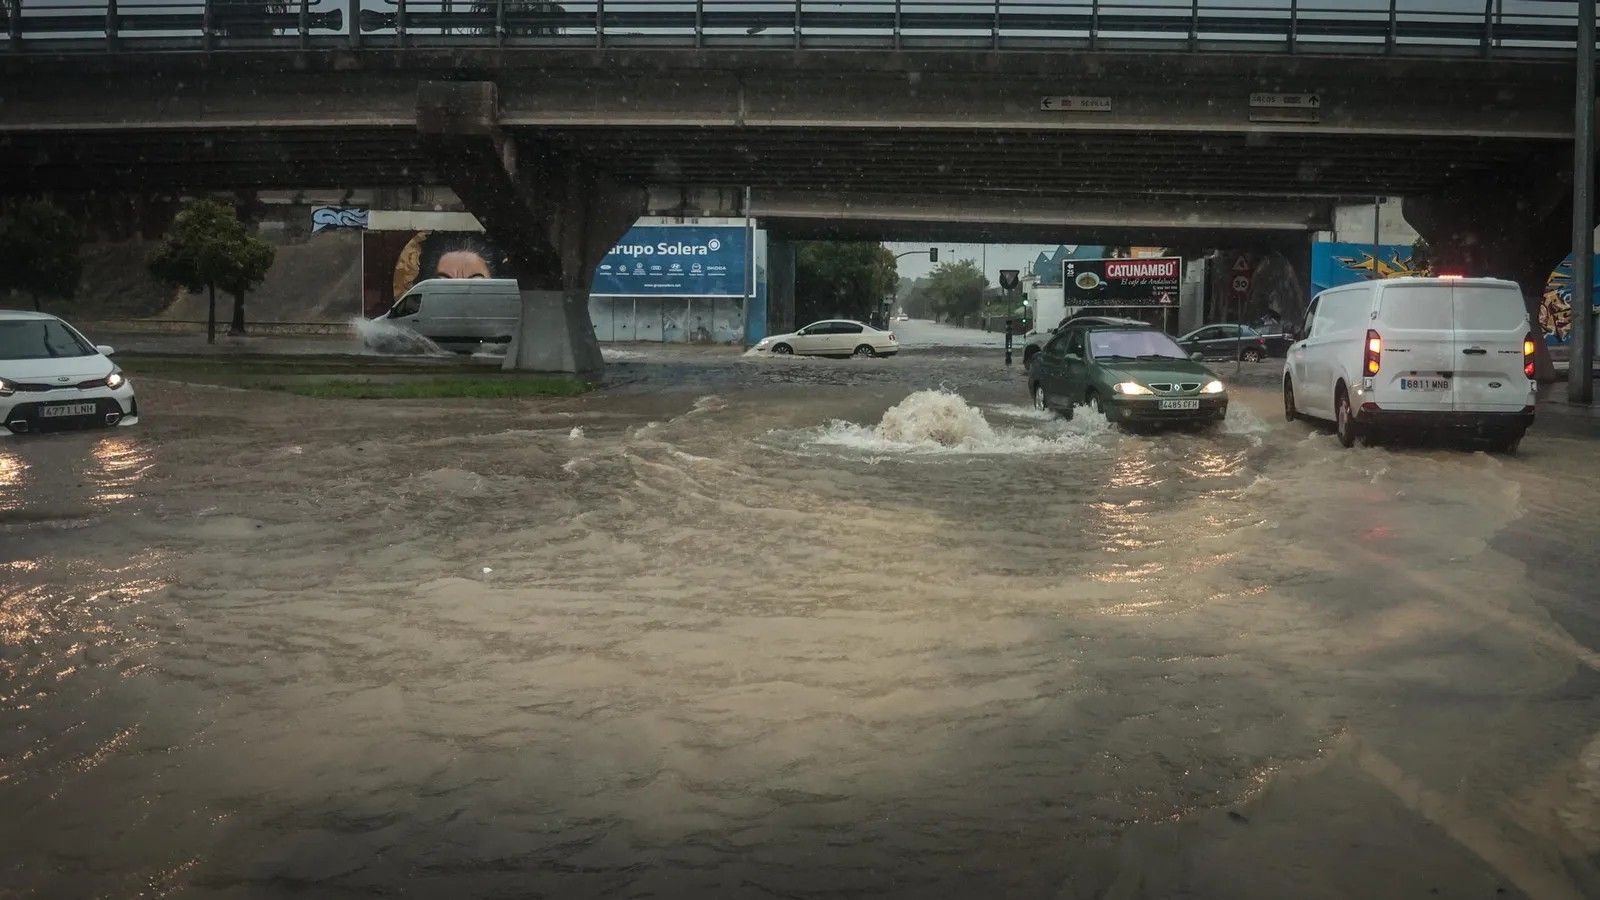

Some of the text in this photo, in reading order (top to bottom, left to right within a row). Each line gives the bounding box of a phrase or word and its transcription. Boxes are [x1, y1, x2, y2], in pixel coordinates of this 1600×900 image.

[657, 242, 708, 255] Solera
[1107, 263, 1173, 277] CATUNAMBÚ
[1235, 280, 1247, 288] 30
[1407, 380, 1449, 389] 6811 MNB
[46, 404, 94, 416] 4771 LNH
